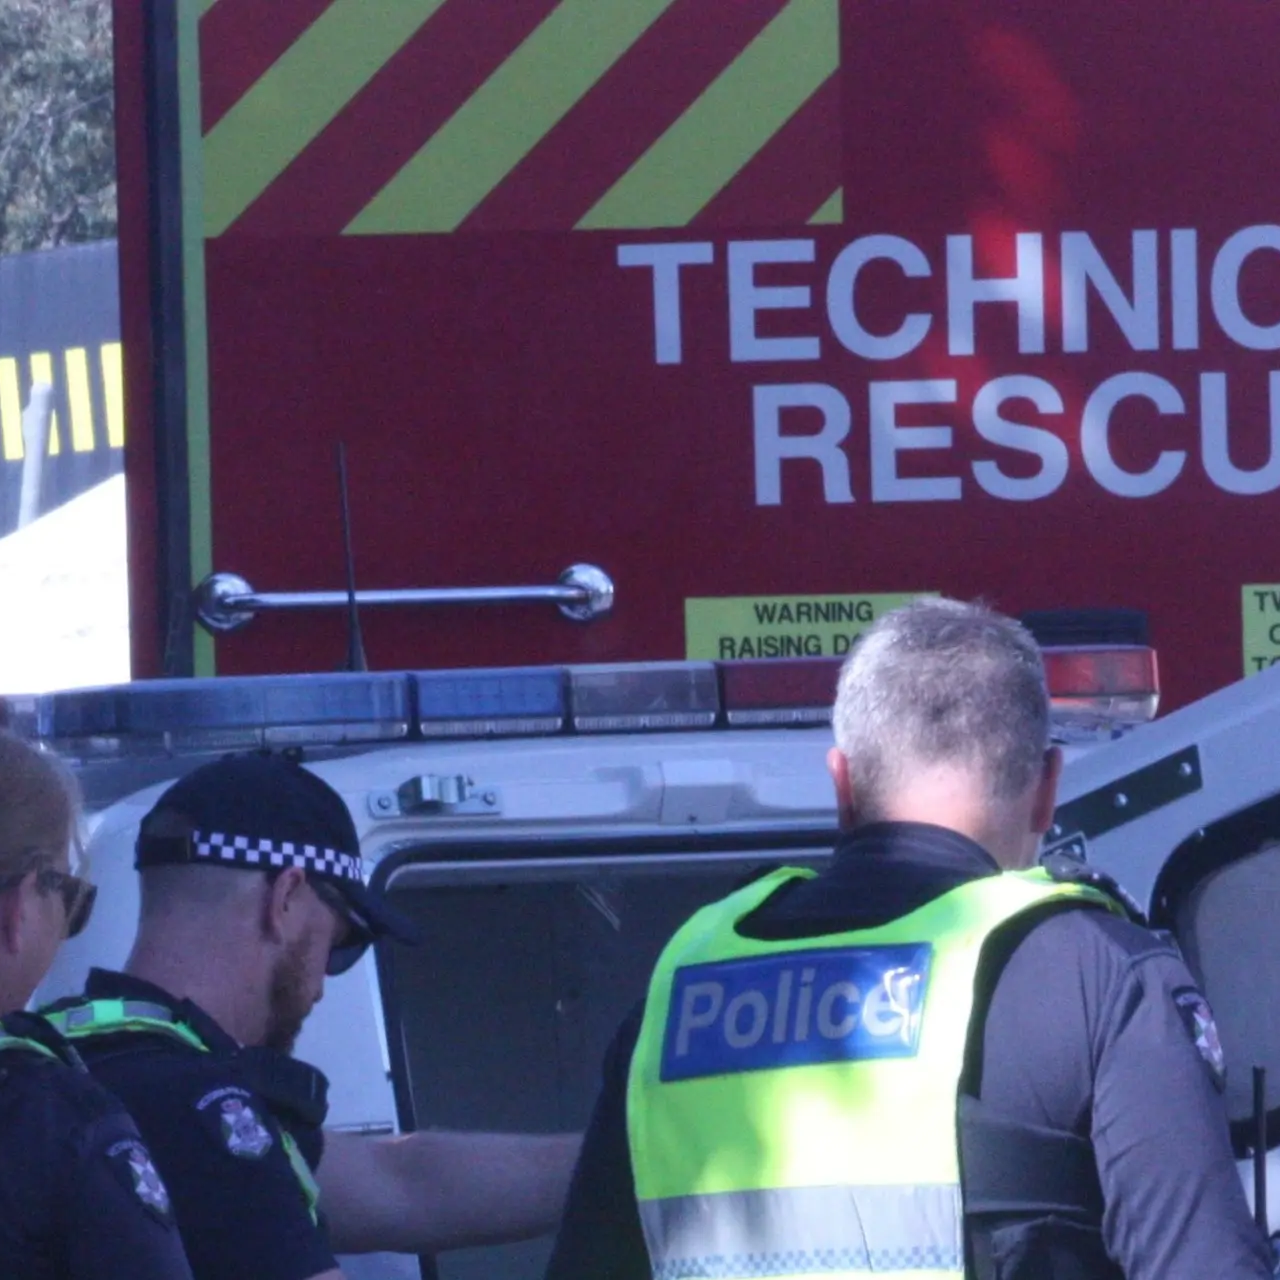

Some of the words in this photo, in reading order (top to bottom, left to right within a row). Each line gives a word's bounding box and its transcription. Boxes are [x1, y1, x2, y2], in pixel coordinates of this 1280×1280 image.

[754, 601, 873, 624] WARNING
[719, 634, 821, 659] RAISING
[674, 969, 918, 1057] Police
